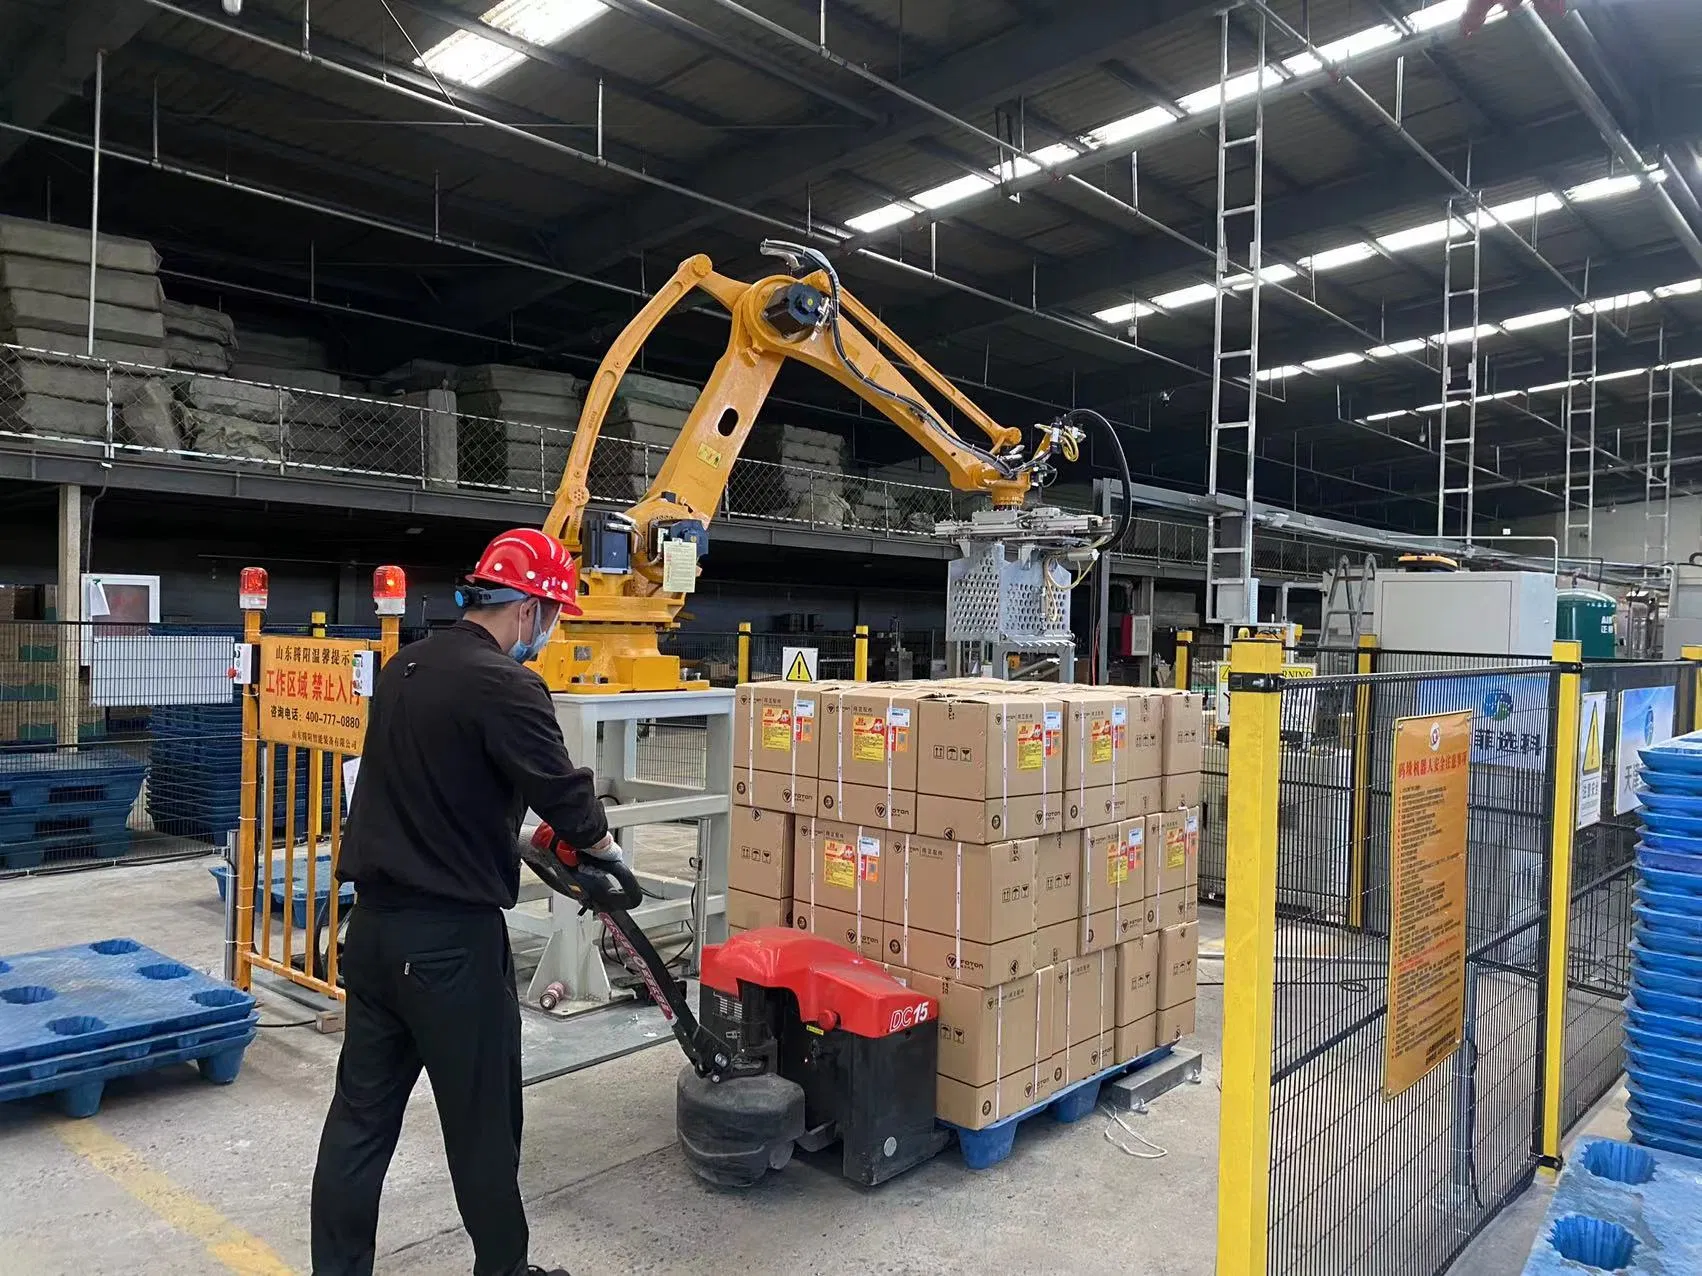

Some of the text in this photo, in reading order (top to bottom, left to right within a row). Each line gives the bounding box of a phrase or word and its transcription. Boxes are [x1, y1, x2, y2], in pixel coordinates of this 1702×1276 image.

[1282, 670, 1312, 678] RNING
[265, 669, 308, 700] 工作区域
[305, 711, 360, 729] 400-777-0880
[960, 959, 984, 970] FOTON
[889, 1001, 929, 1032] DC15
